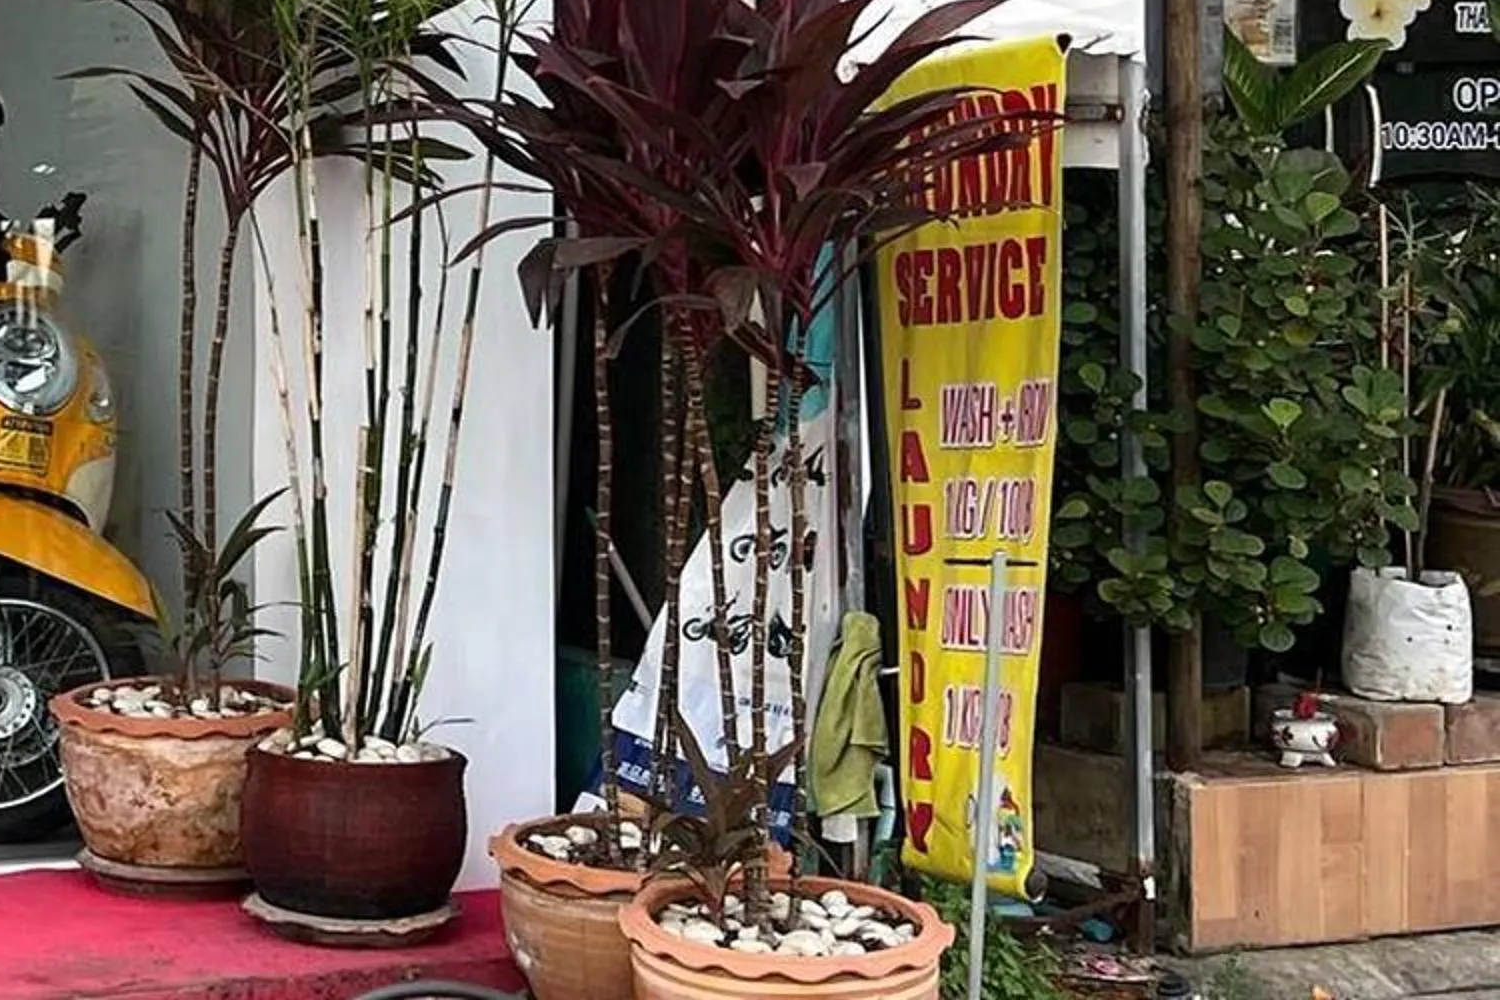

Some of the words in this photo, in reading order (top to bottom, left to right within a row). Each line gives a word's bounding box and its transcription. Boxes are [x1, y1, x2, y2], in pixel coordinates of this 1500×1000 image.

[895, 236, 1047, 329] SERVICE
[940, 383, 997, 449] WASH
[900, 357, 934, 855] LAUNDRY
[941, 585, 991, 649] ONLY
[1001, 587, 1039, 653] ASH
